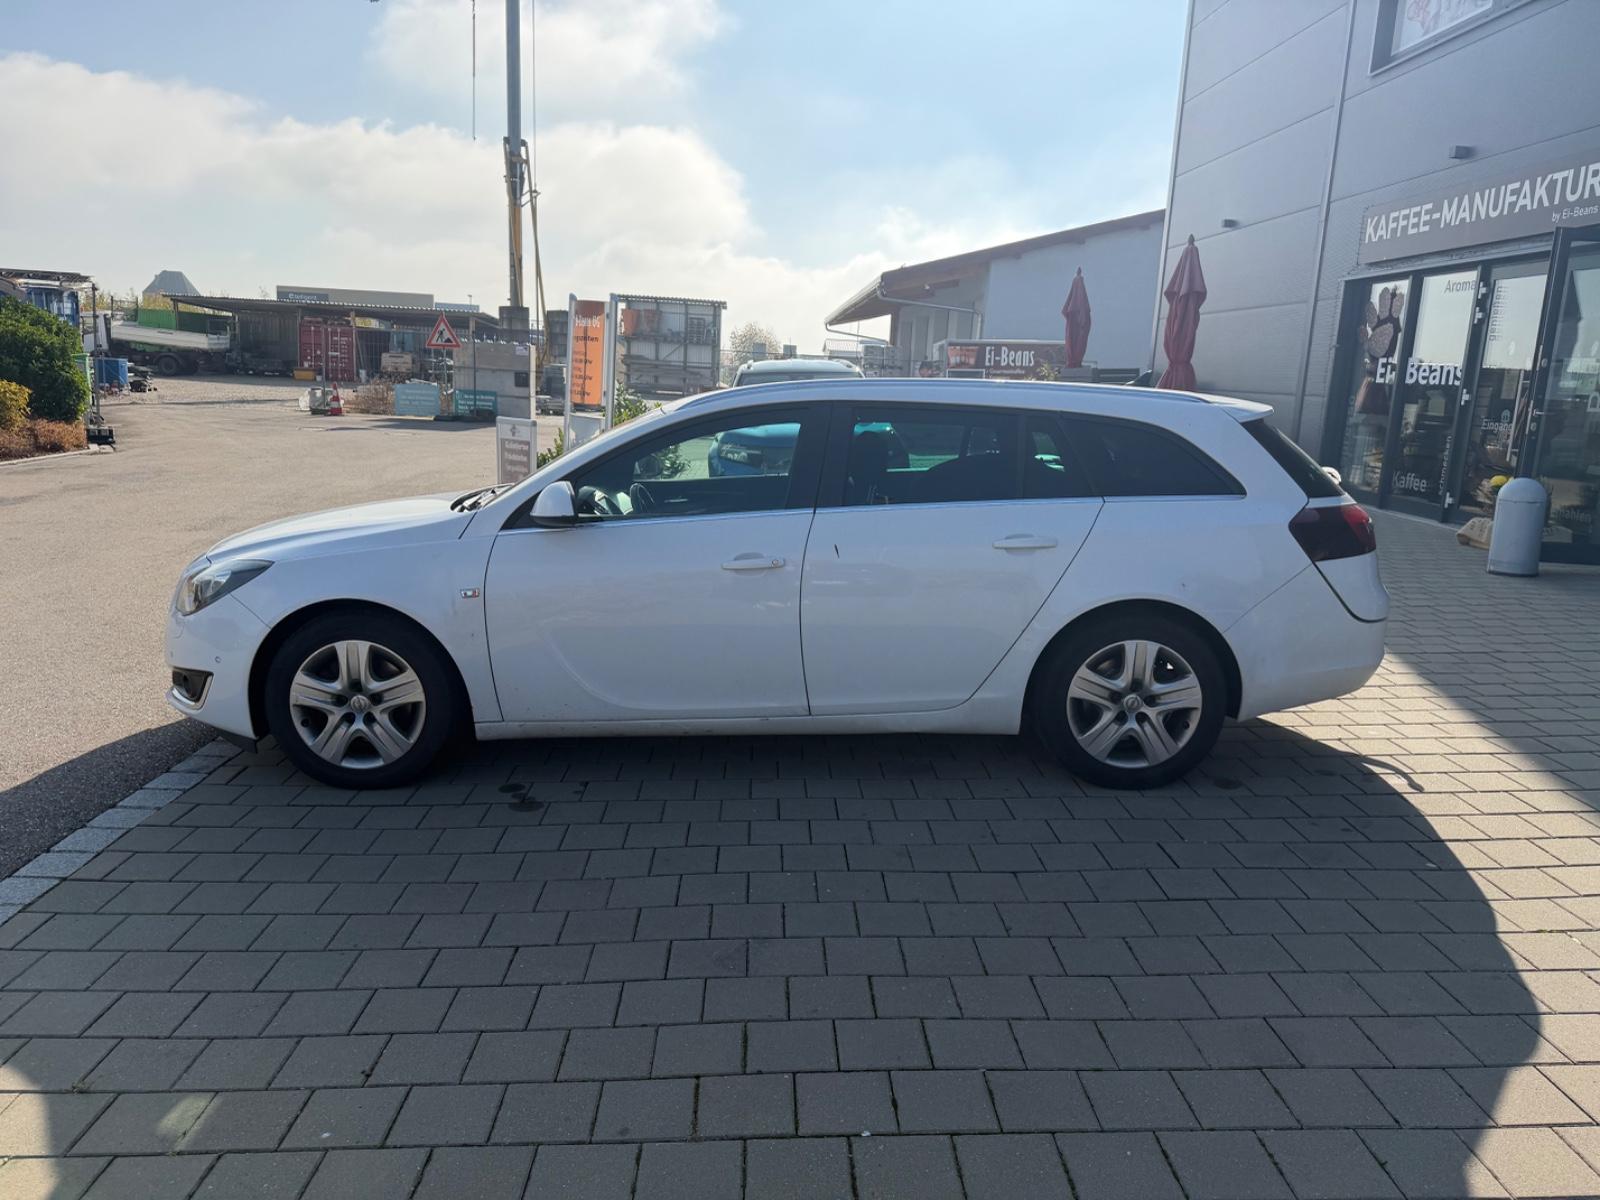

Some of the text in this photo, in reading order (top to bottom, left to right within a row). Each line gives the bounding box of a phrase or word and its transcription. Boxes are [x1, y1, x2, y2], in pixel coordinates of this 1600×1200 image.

[1364, 162, 1600, 243] KAFFEE-MANUFAKTUR
[1552, 211, 1561, 223] by
[1445, 279, 1477, 294] Aroma
[985, 346, 1035, 367] Ei-Beans
[1392, 471, 1427, 492] Kaffee
